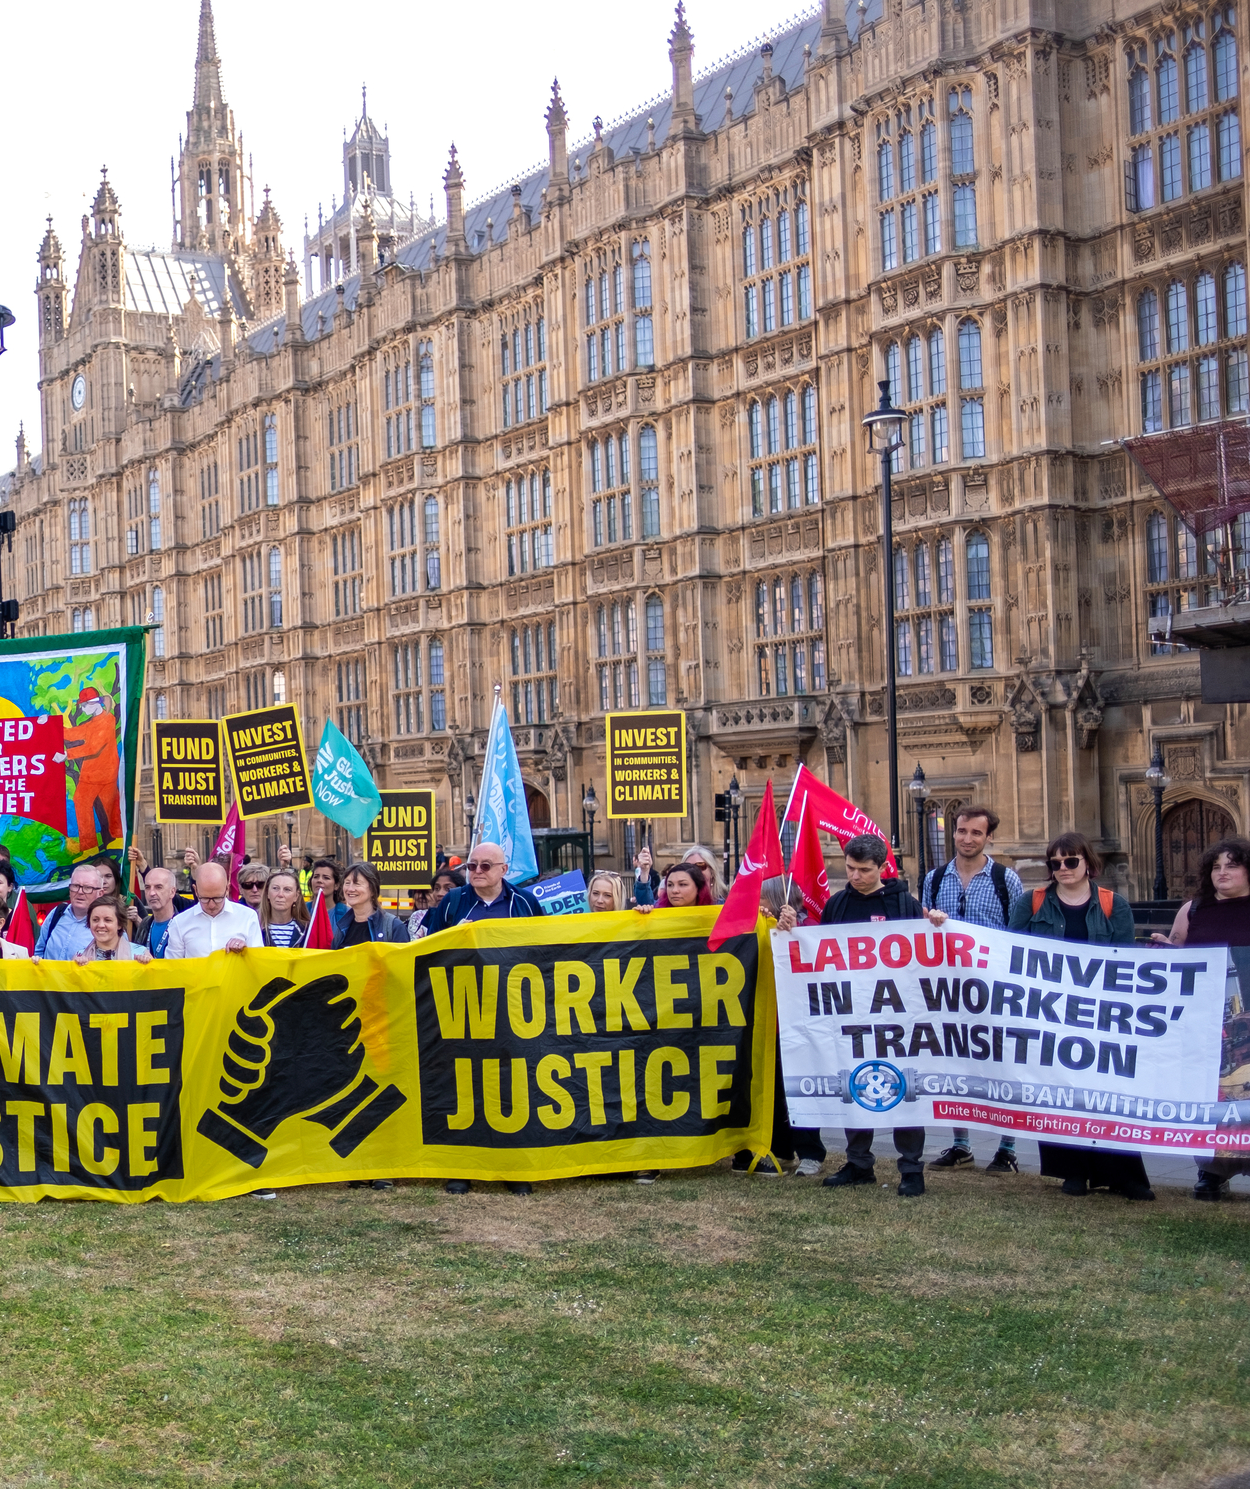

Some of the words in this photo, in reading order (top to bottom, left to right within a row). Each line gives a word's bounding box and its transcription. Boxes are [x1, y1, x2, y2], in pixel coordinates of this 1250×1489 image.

[232, 720, 293, 749] INVEST
[614, 727, 678, 747] INVEST
[161, 737, 215, 760] FUND
[236, 758, 245, 767] IN
[246, 748, 299, 766] COMMUNITIES,
[239, 763, 290, 783] WORKERS
[292, 761, 302, 773] &
[614, 757, 622, 766] IN
[623, 756, 680, 766] COMMUNITIES,
[162, 772, 174, 790] A
[177, 772, 216, 791] JUST
[615, 769, 668, 781] WORKERS
[670, 768, 680, 780] &
[162, 794, 217, 806] TRANSITION
[242, 776, 305, 802] CLIMATE
[614, 784, 680, 801] CLIMATE
[372, 806, 427, 827] FUND
[371, 839, 383, 857] A
[387, 838, 428, 857] JUST
[788, 932, 990, 973] LABOUR:
[1009, 945, 1208, 996] INVEST
[428, 952, 747, 1040] WORKER
[807, 980, 854, 1017] IN
[869, 979, 907, 1014] A
[919, 977, 1185, 1038] WORKERS'
[841, 1022, 1138, 1079] TRANSITION
[447, 1044, 737, 1134] JUSTICE
[799, 1077, 836, 1095] OIL
[865, 1071, 892, 1099] &
[922, 1074, 969, 1095] GAS
[987, 1081, 1014, 1101] NO
[1021, 1083, 1075, 1108] BAN
[1083, 1089, 1215, 1123] WITHOUT
[1221, 1102, 1242, 1123] A
[939, 1104, 970, 1117] Unite
[972, 1106, 988, 1119] the
[989, 1108, 1014, 1125] union
[1026, 1115, 1081, 1135] Fighting
[1084, 1121, 1107, 1135] for
[1111, 1125, 1152, 1141] JOBS
[1163, 1131, 1194, 1143] PAY
[1205, 1133, 1250, 1145] COND
